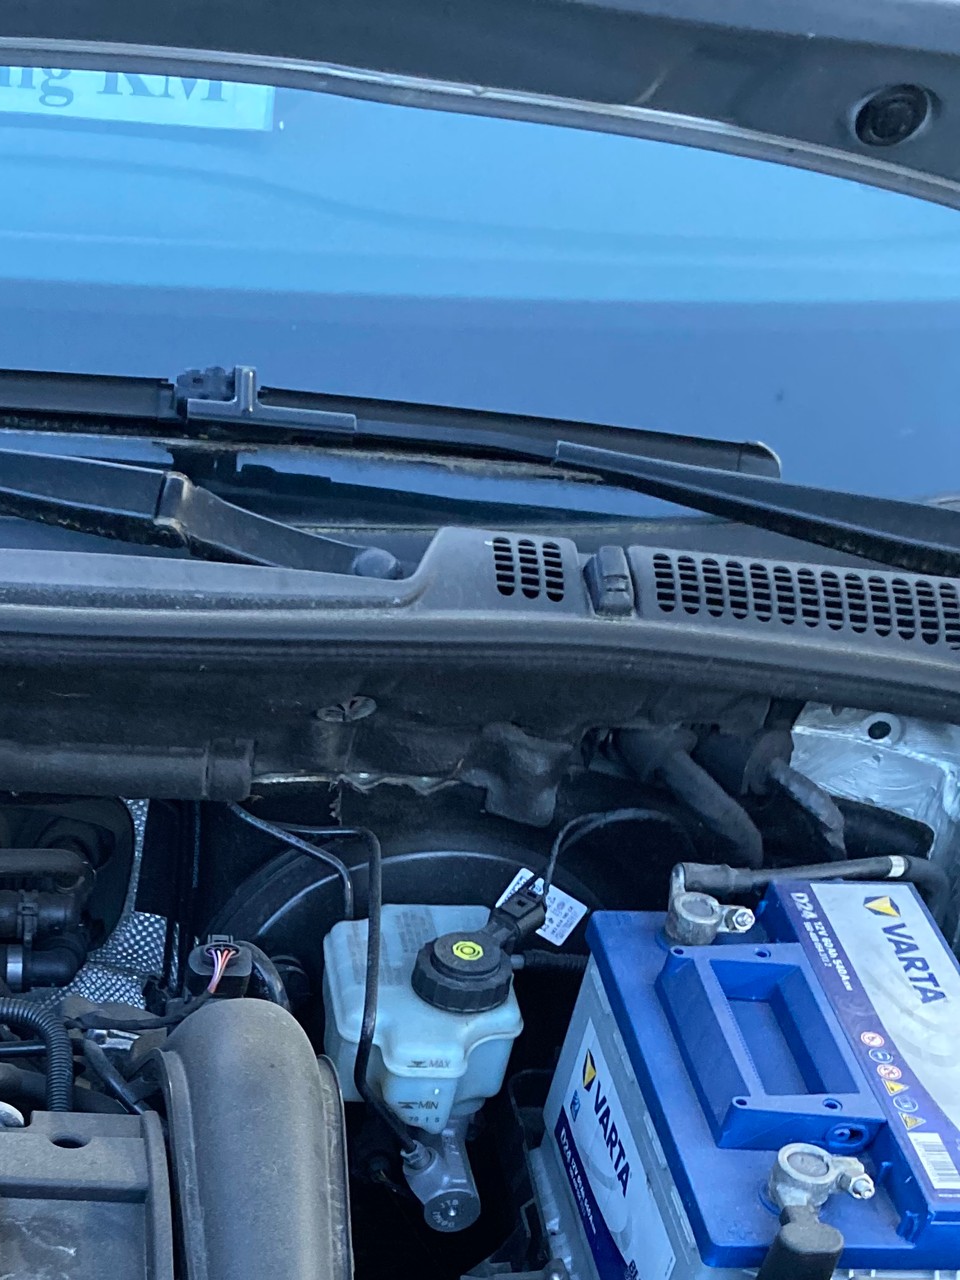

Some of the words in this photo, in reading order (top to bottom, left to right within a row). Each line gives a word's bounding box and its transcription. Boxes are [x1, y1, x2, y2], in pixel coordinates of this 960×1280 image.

[791, 892, 818, 919] D24
[882, 923, 947, 1004] VARTA
[429, 1059, 450, 1068] MAX
[418, 1101, 439, 1109] MIN
[594, 1080, 630, 1198] VARTA
